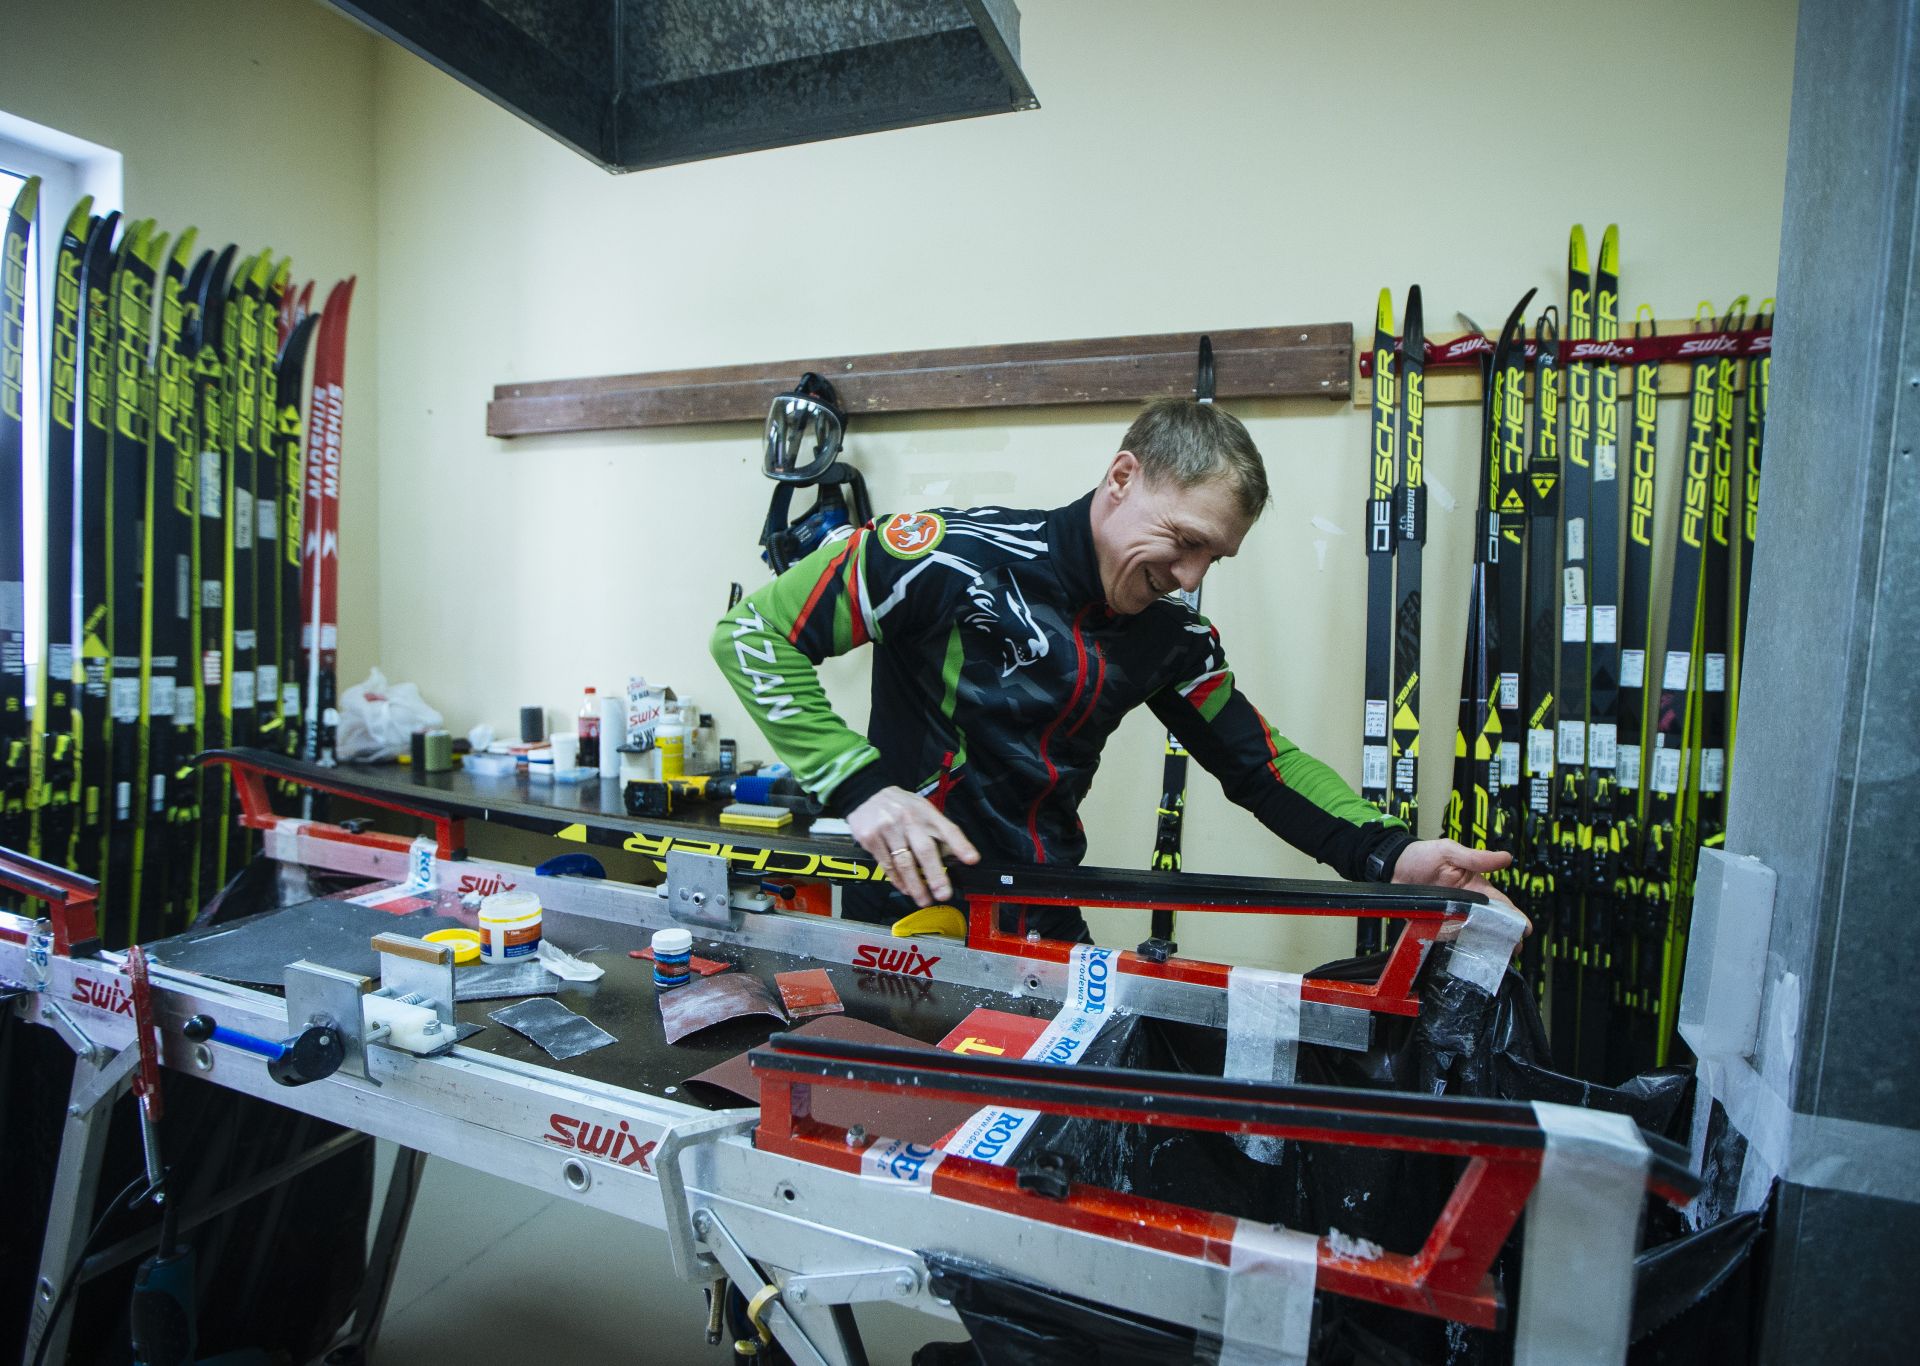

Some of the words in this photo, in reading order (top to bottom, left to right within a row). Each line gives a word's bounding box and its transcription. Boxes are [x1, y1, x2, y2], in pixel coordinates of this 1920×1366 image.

[1, 231, 27, 421] FISCHER
[52, 249, 82, 430] FISCHER
[157, 274, 183, 443] FISCHER
[237, 294, 258, 453] FISCHER
[260, 302, 279, 457] FISCHER
[307, 384, 327, 499] MADSHUS
[324, 382, 344, 499] MADSHUS
[1407, 371, 1422, 488] SCHER
[1541, 367, 1557, 457] CHER
[1631, 363, 1658, 547] FISCHER
[1682, 363, 1717, 548] FISCHER
[1712, 357, 1737, 546] FISCHER
[732, 602, 803, 722] AZAN
[623, 832, 892, 882] ISCHER
[1083, 947, 1113, 1015] RODE
[968, 1112, 1025, 1164] ROD
